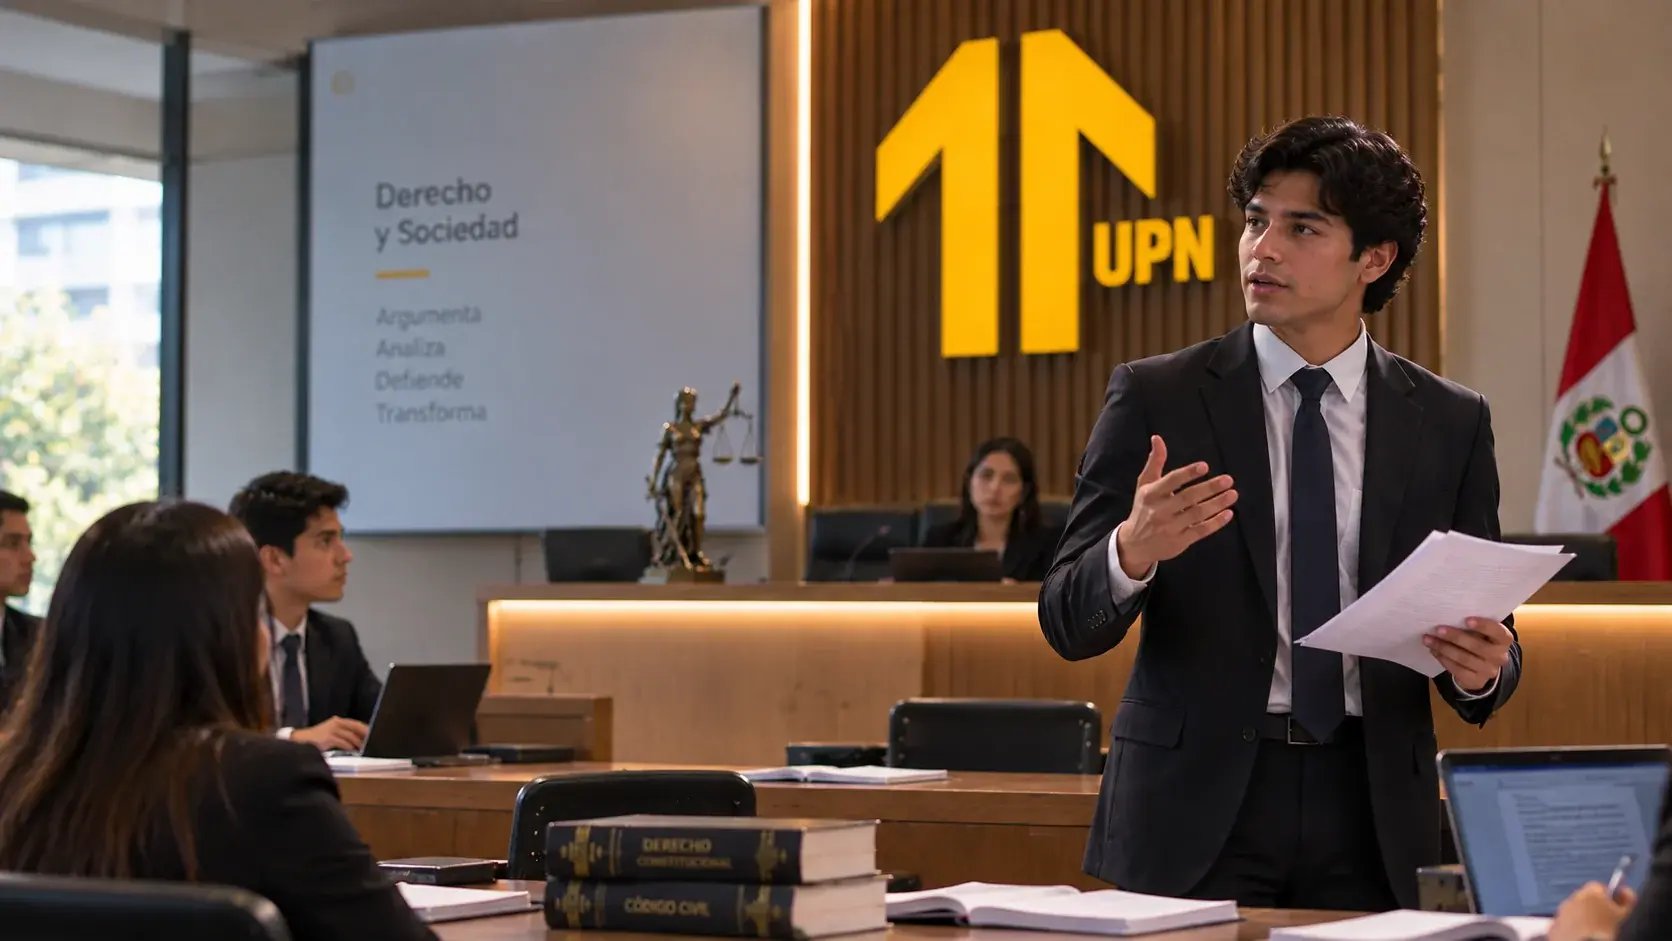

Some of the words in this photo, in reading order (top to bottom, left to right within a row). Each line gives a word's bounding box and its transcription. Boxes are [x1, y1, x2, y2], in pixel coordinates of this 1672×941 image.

[375, 177, 492, 209] Derecho
[374, 224, 391, 252] y
[398, 212, 519, 246] Sociedad
[1093, 214, 1214, 287] UPN
[376, 305, 482, 330] Argumenta
[376, 338, 446, 358] Analiza
[375, 368, 464, 391] Defiende
[375, 400, 487, 424] Transforma
[643, 838, 711, 853] DERECHO
[624, 896, 677, 915] CÓDIGO
[679, 900, 710, 916] CIVIL
